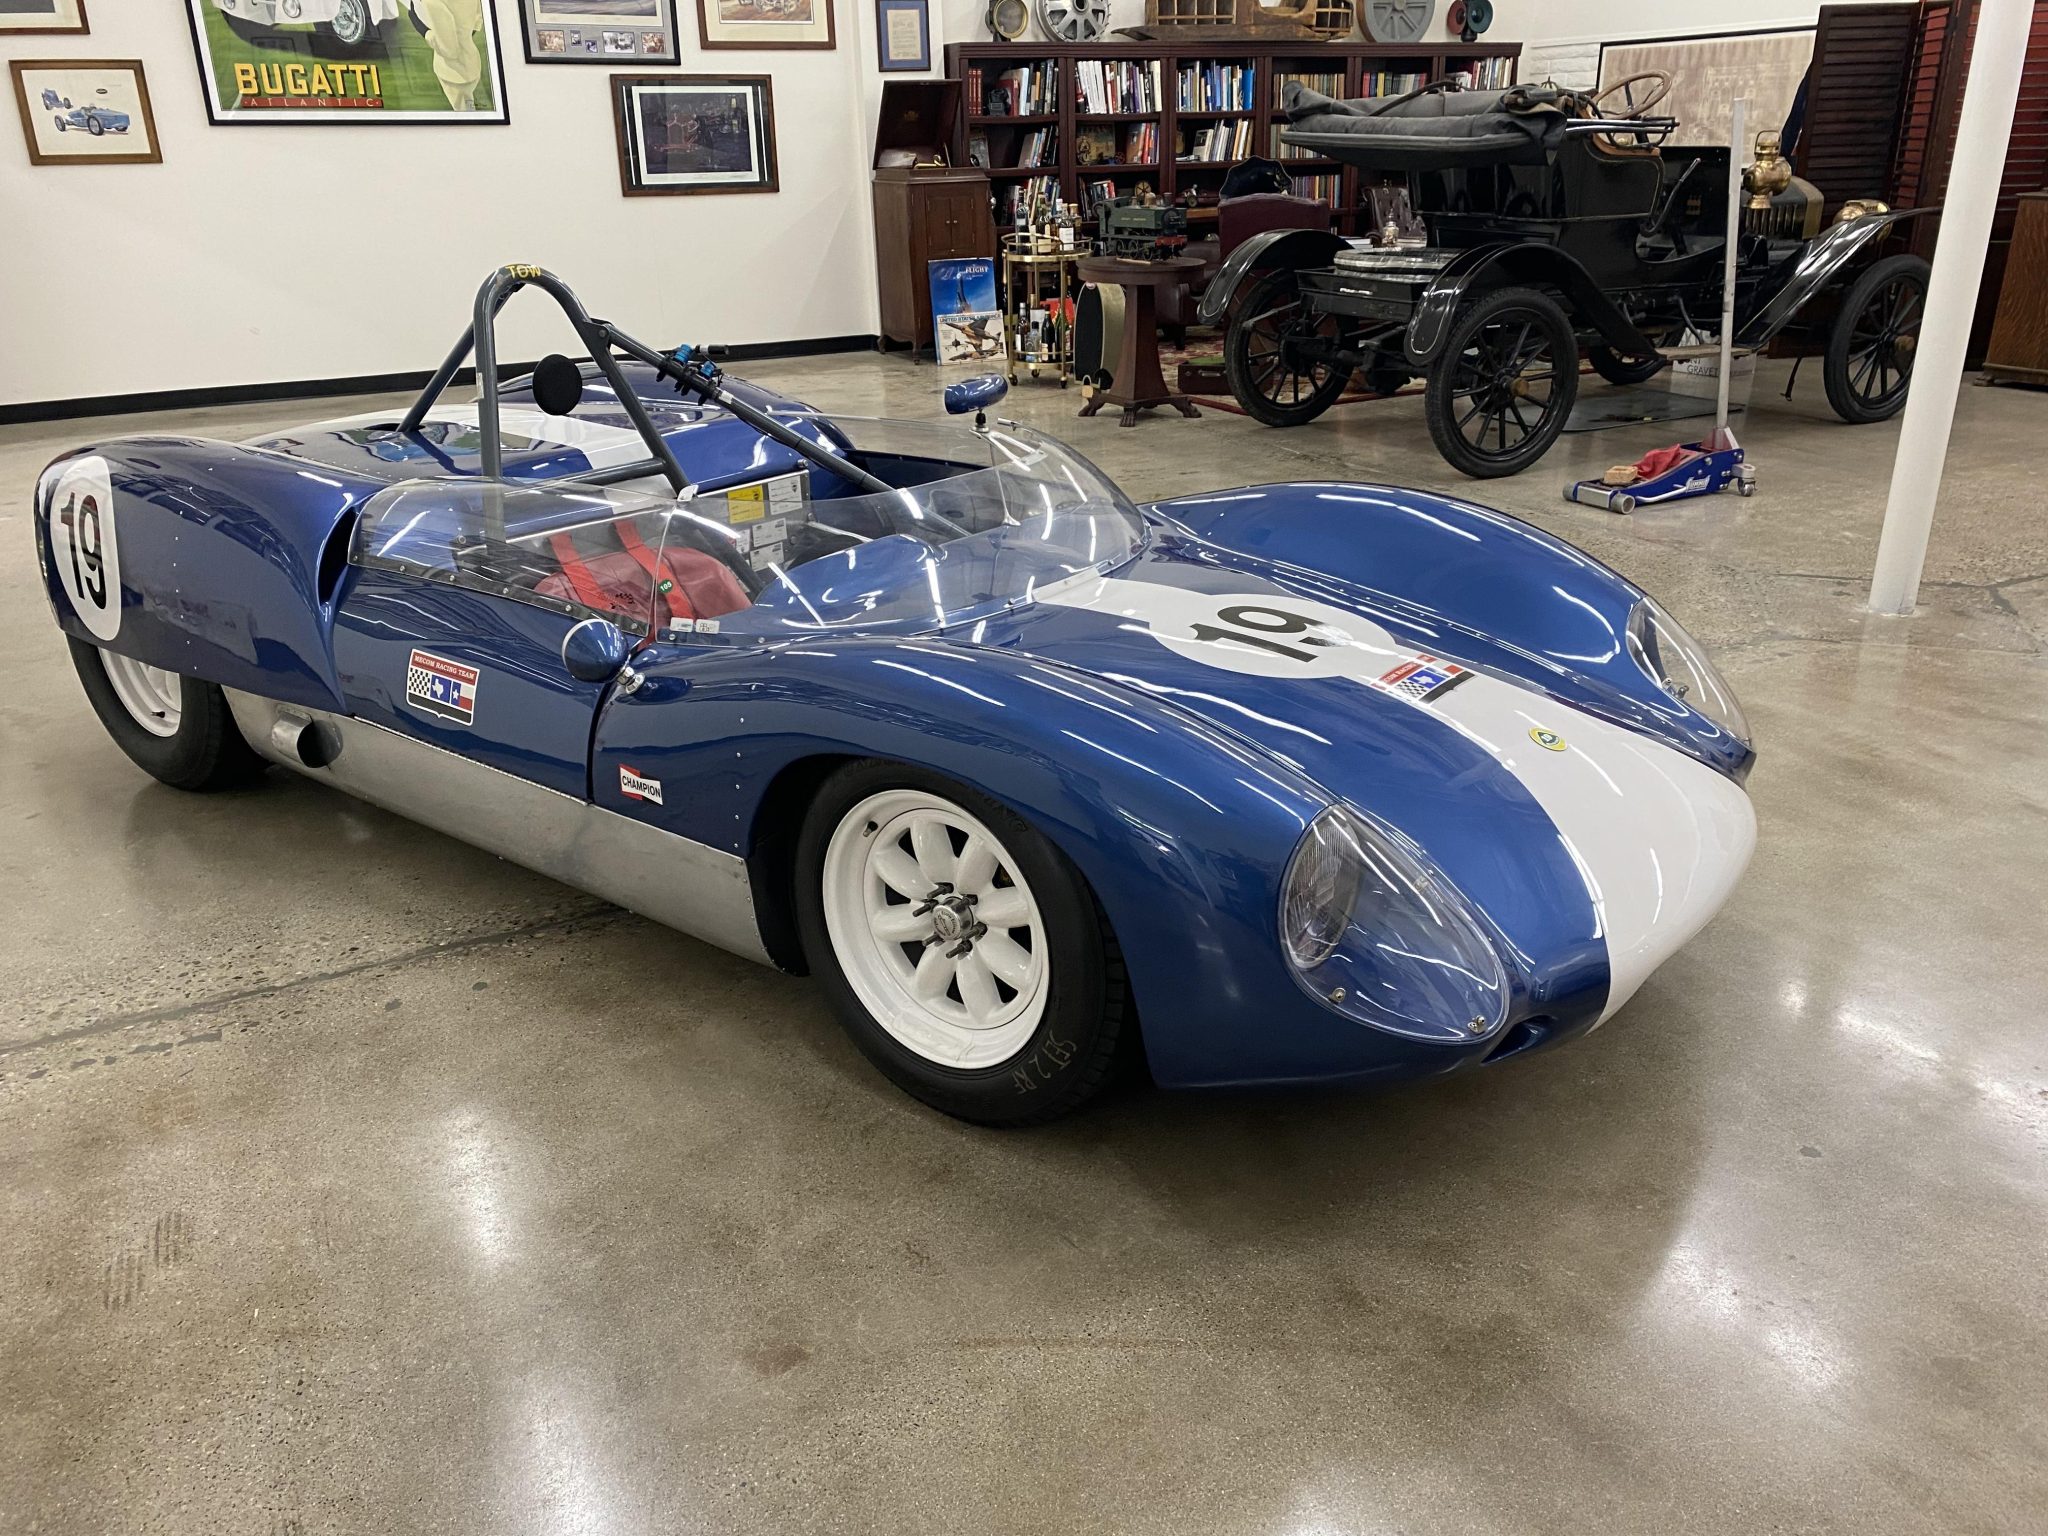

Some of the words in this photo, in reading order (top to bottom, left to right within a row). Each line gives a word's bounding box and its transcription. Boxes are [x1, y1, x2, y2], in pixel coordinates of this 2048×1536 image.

[234, 63, 382, 96] BUGATTI
[249, 98, 376, 107] ATLANTIC
[505, 264, 541, 279] TOW
[965, 265, 989, 274] FLIGHT
[60, 492, 107, 610] 19
[1189, 605, 1336, 663] 19
[414, 655, 435, 667] MECOM
[436, 662, 457, 674] RACING
[458, 669, 475, 680] TEAM
[622, 775, 661, 798] CHAMPION
[1028, 1054, 1051, 1079] 2
